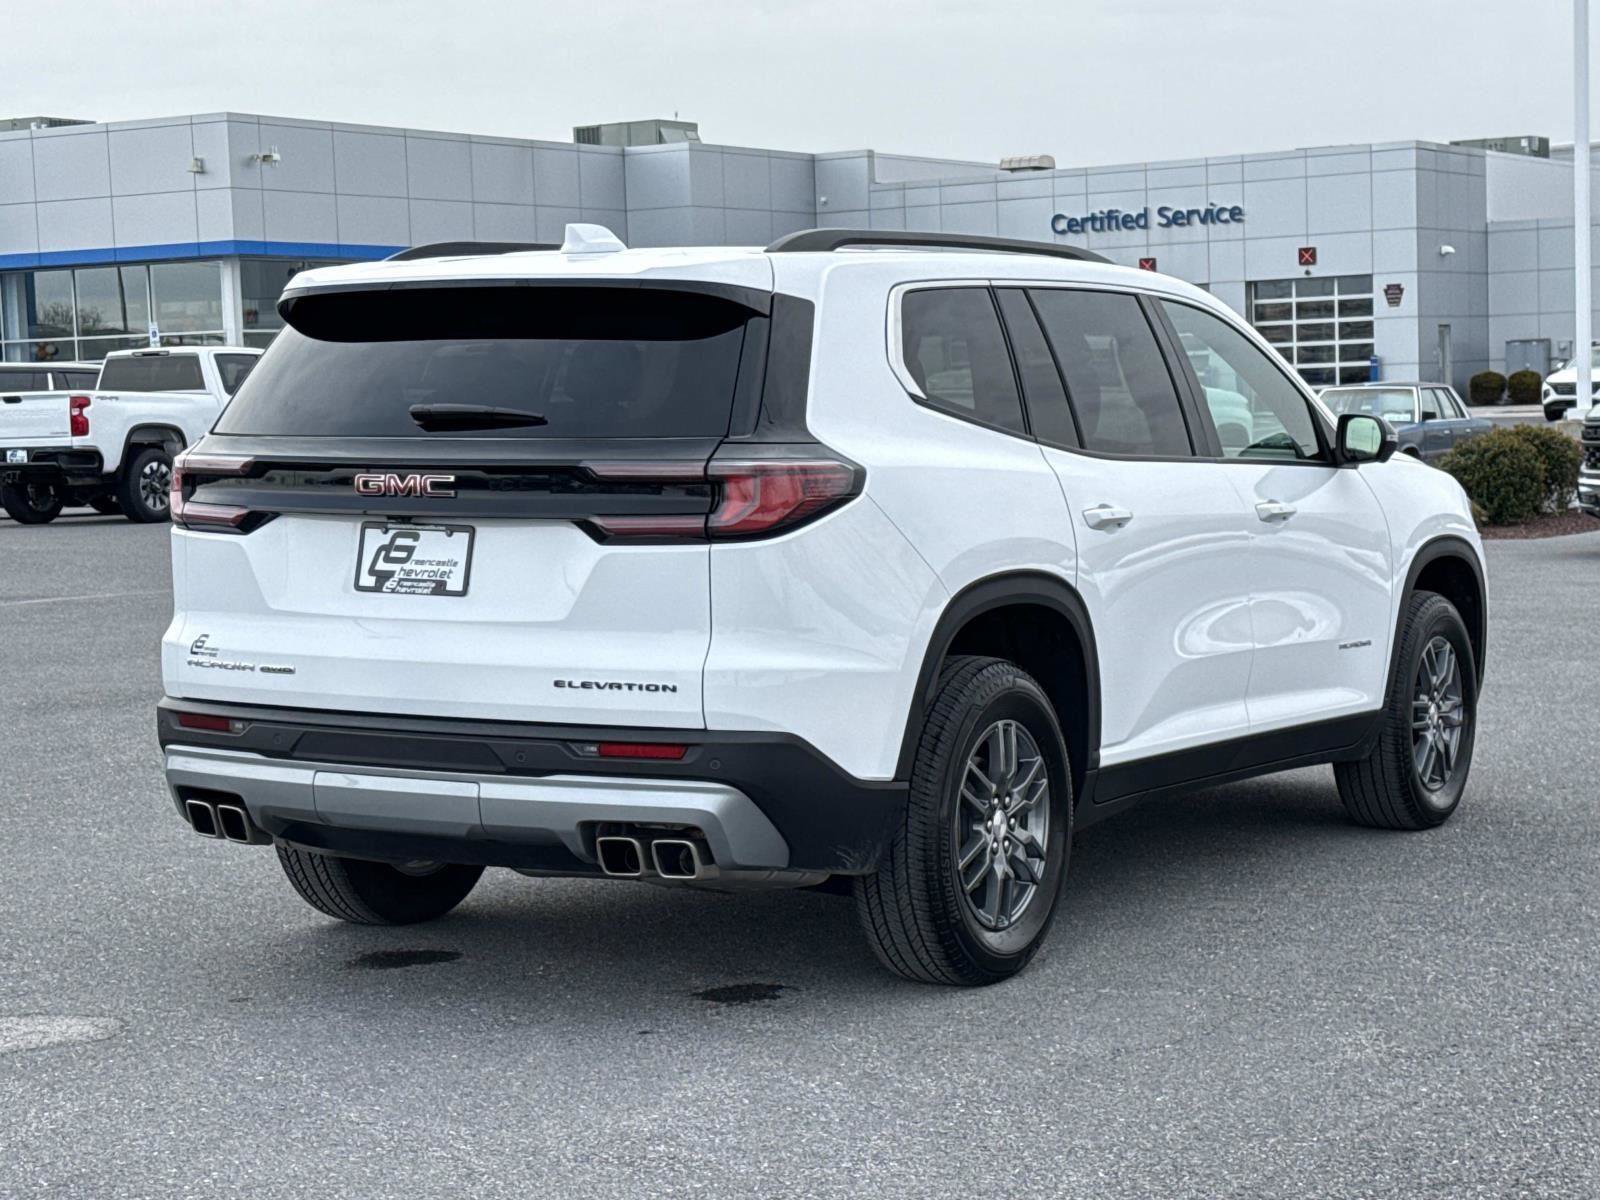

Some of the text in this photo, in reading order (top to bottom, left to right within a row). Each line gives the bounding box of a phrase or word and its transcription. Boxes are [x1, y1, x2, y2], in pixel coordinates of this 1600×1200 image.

[1051, 202, 1245, 235] Certified Service
[354, 473, 456, 497] GMC
[553, 679, 678, 693] ELEVATION
